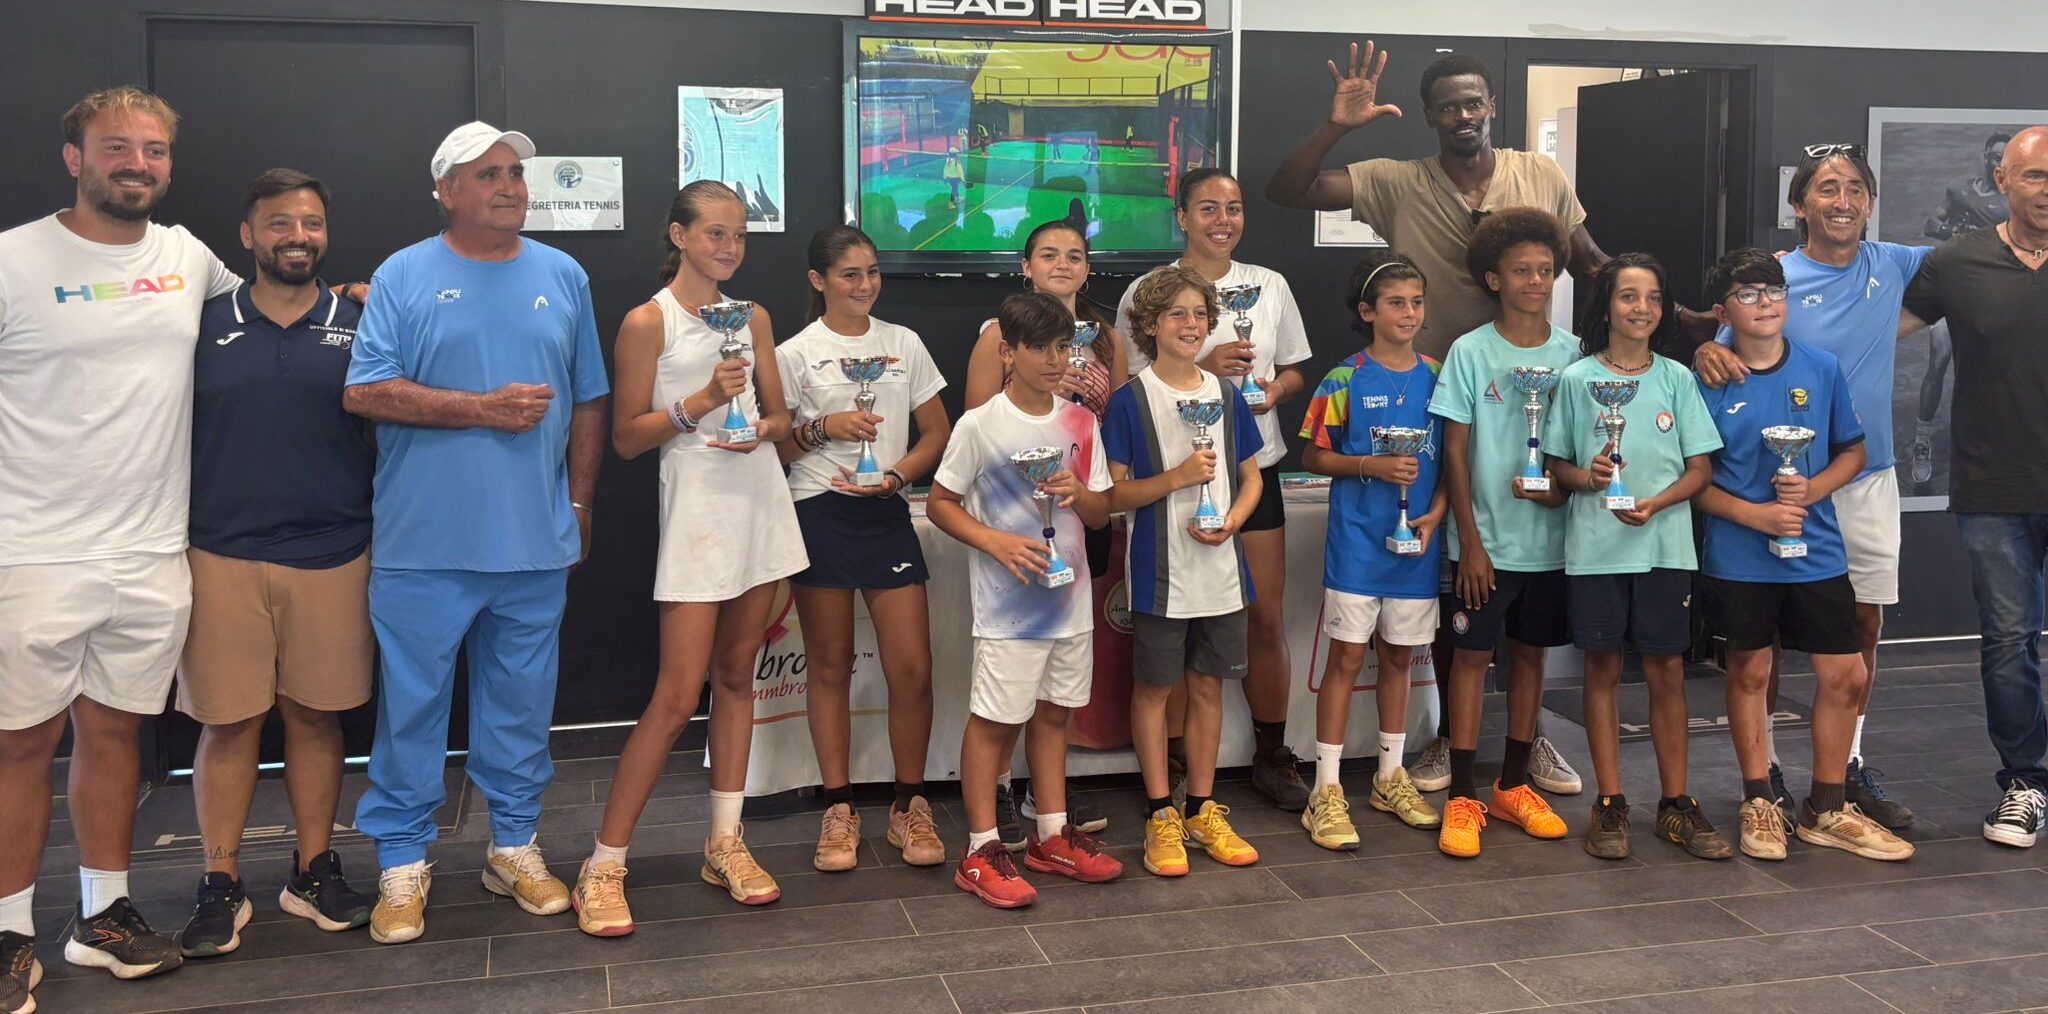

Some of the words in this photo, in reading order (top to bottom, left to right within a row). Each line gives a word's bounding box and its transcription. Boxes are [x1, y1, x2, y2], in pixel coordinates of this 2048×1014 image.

[875, 0, 1035, 17] HEAD
[1050, 0, 1202, 21] HEAD
[526, 201, 581, 210] EGRETERIA
[583, 201, 620, 210] TENNIS
[54, 274, 185, 304] HEAD
